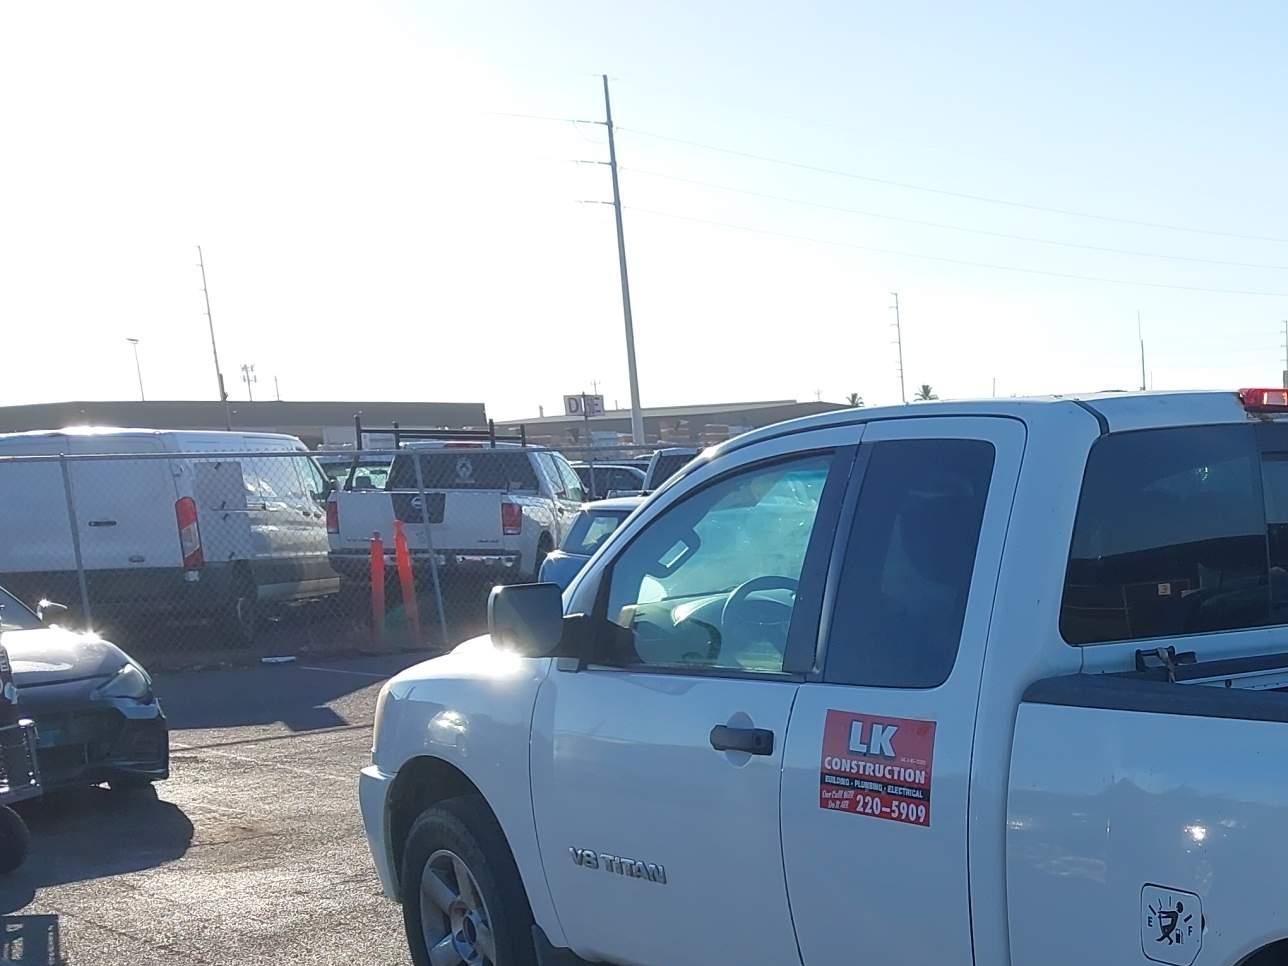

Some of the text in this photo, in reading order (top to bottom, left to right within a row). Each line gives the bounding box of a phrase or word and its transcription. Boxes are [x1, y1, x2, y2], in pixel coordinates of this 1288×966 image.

[849, 720, 898, 757] LK
[824, 756, 925, 784] CONSTRUCTION
[887, 785, 923, 798] ELECTRICAL
[856, 795, 926, 822] 220-5909
[568, 847, 667, 884] V8 TITAN
[1148, 916, 1153, 927] E
[1188, 926, 1193, 936] F
